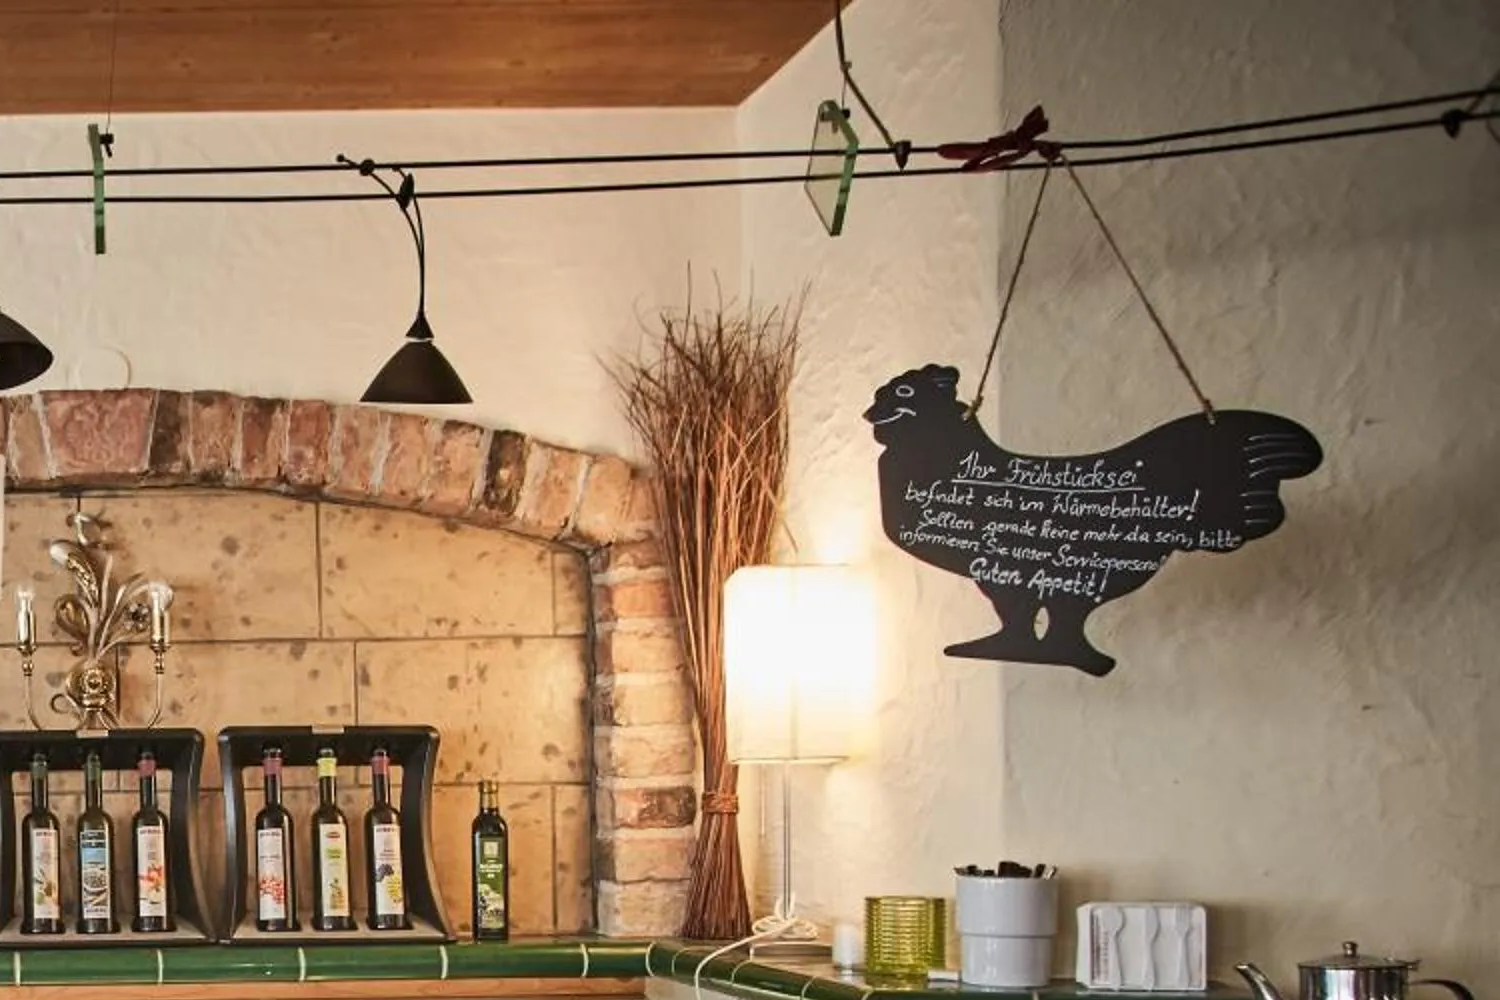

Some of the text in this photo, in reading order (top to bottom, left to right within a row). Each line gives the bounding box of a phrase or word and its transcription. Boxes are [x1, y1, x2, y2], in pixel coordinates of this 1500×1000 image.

[956, 450, 1144, 489] Ihr Frühstücksei
[904, 479, 1200, 522] befindet sich im Wärmebehälter!
[900, 524, 981, 548] informieren
[983, 537, 1011, 556] Sie
[1011, 546, 1053, 562] unser
[981, 519, 1037, 542] gerade
[1039, 518, 1080, 542] keine
[1083, 523, 1122, 542] mehr
[1123, 524, 1150, 544] da
[1153, 528, 1194, 548] sein,
[1199, 528, 1243, 549] bitte
[968, 557, 1111, 603] Guten Appetit!
